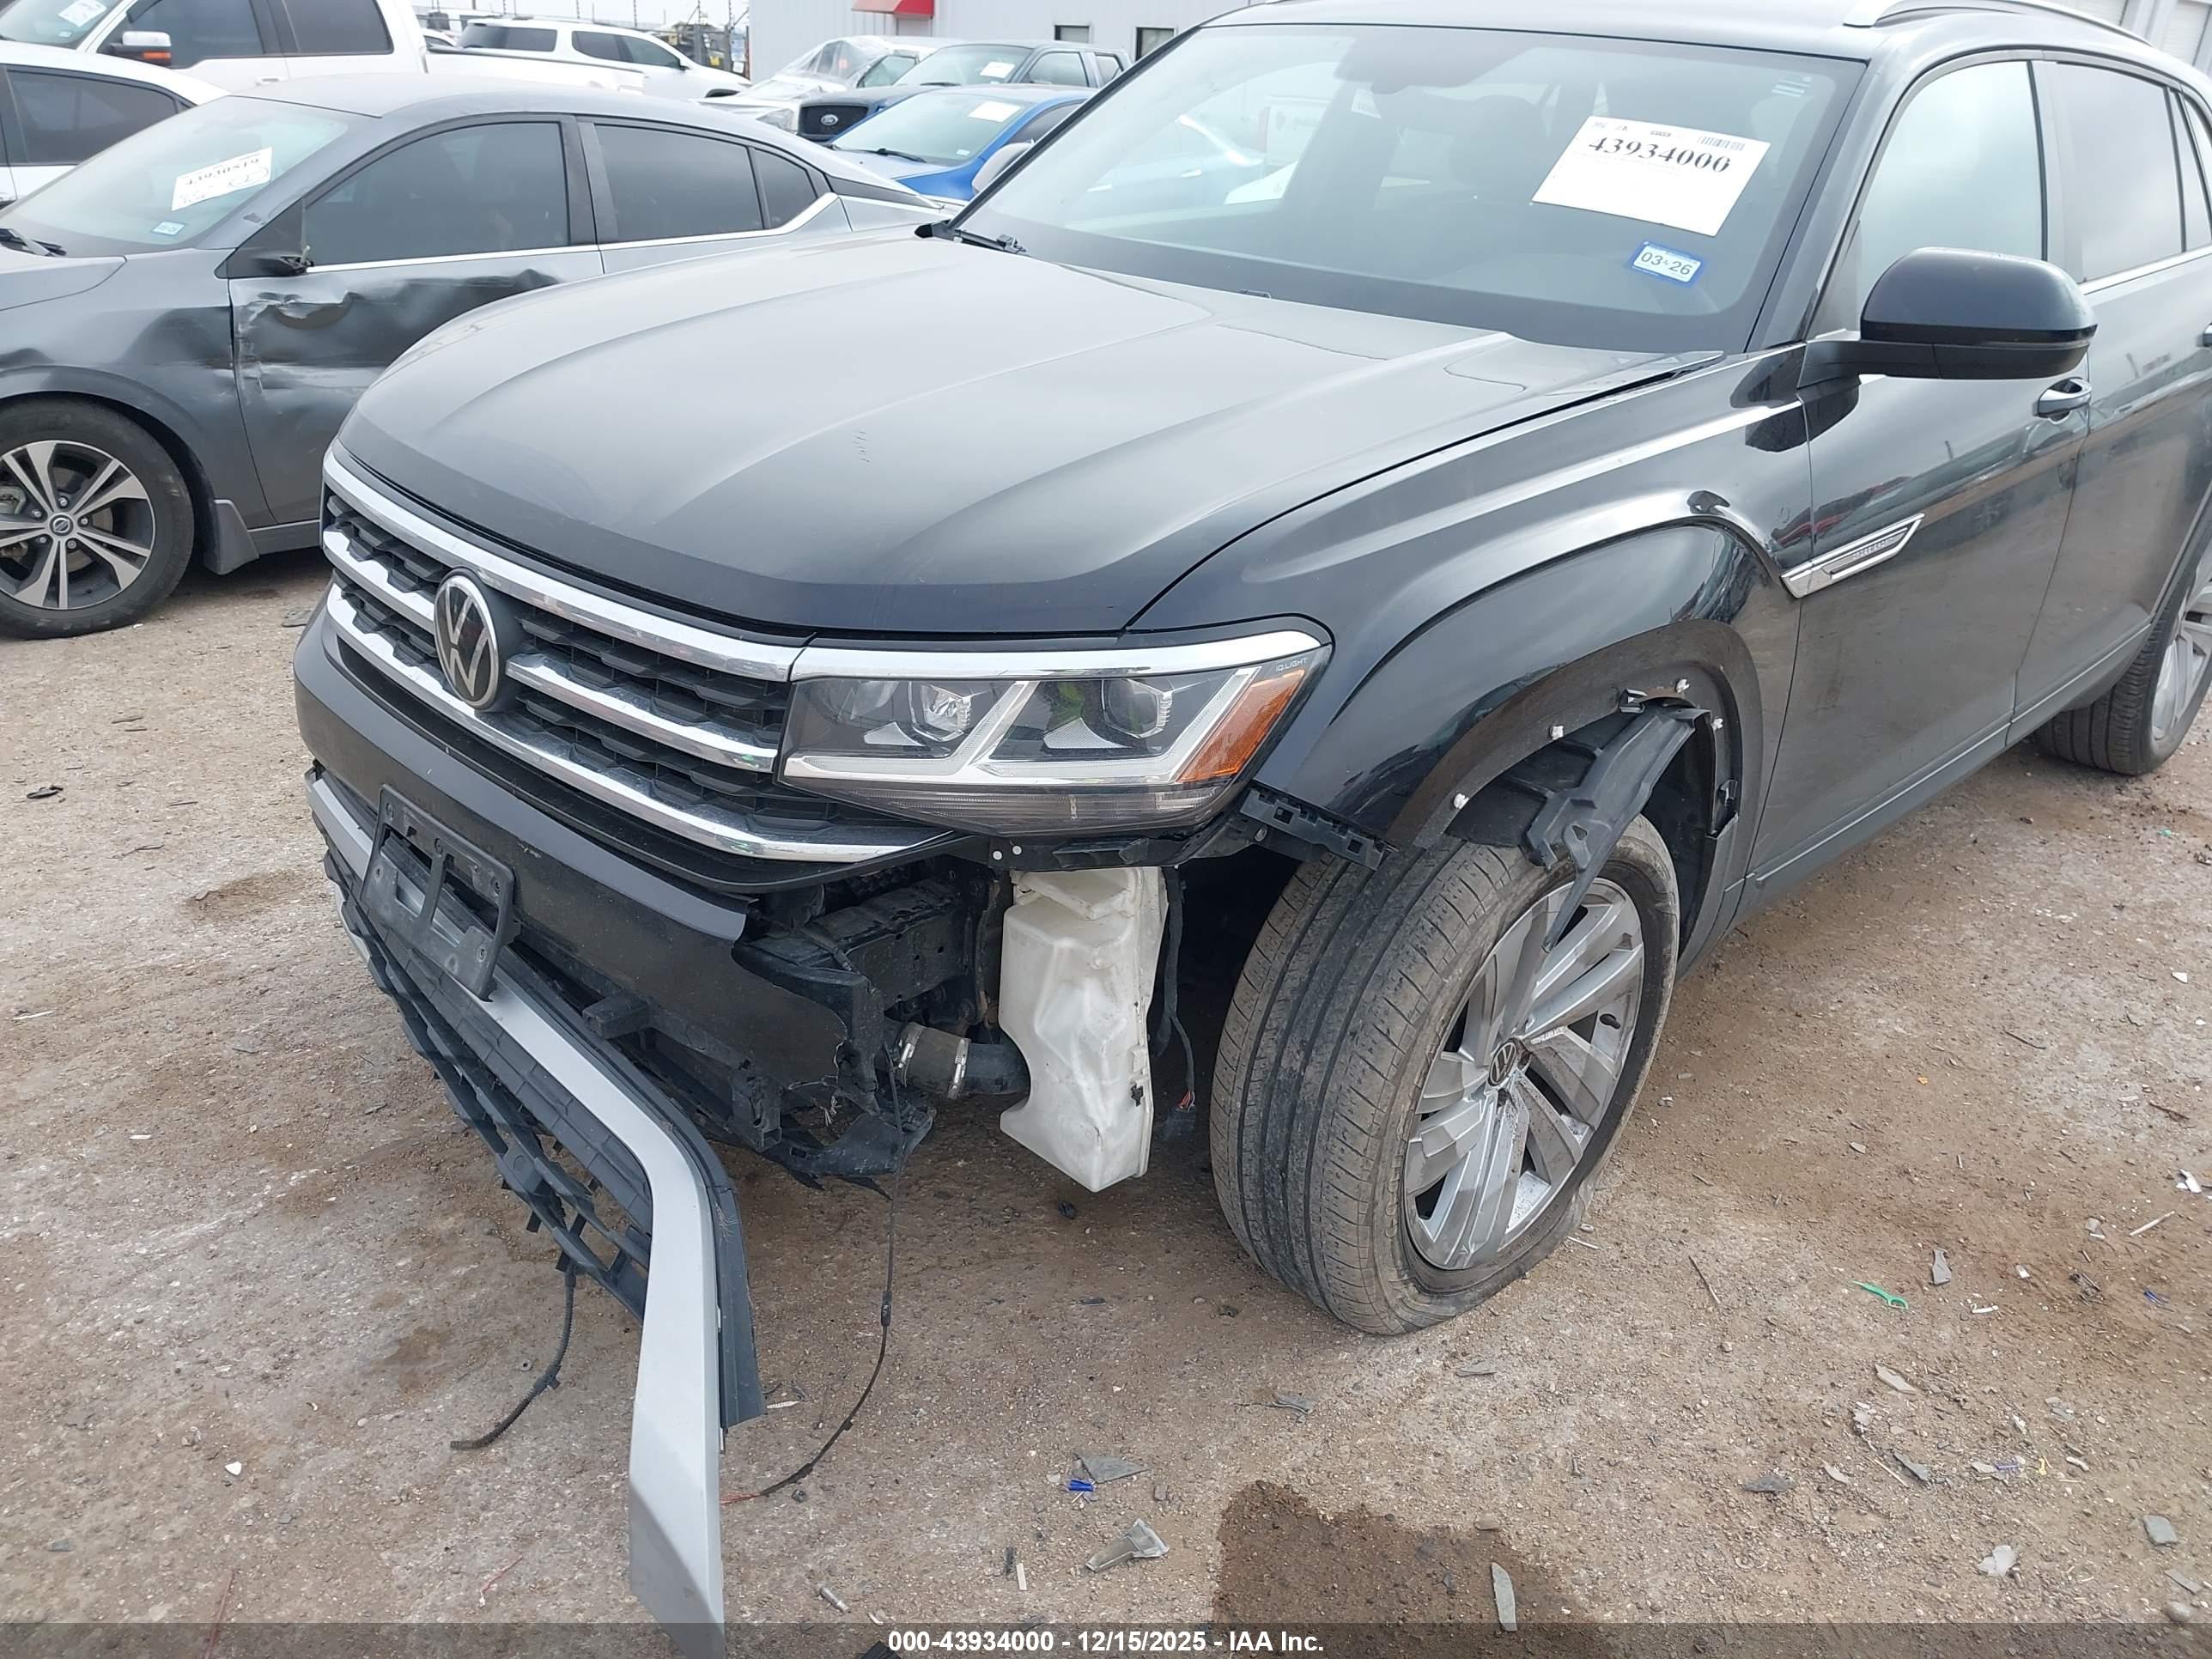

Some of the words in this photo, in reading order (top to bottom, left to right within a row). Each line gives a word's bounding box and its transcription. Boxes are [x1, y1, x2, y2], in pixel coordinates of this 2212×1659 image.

[1589, 137, 1730, 173] 43934000
[1640, 252, 1663, 266] 03
[1668, 260, 1692, 276] 26
